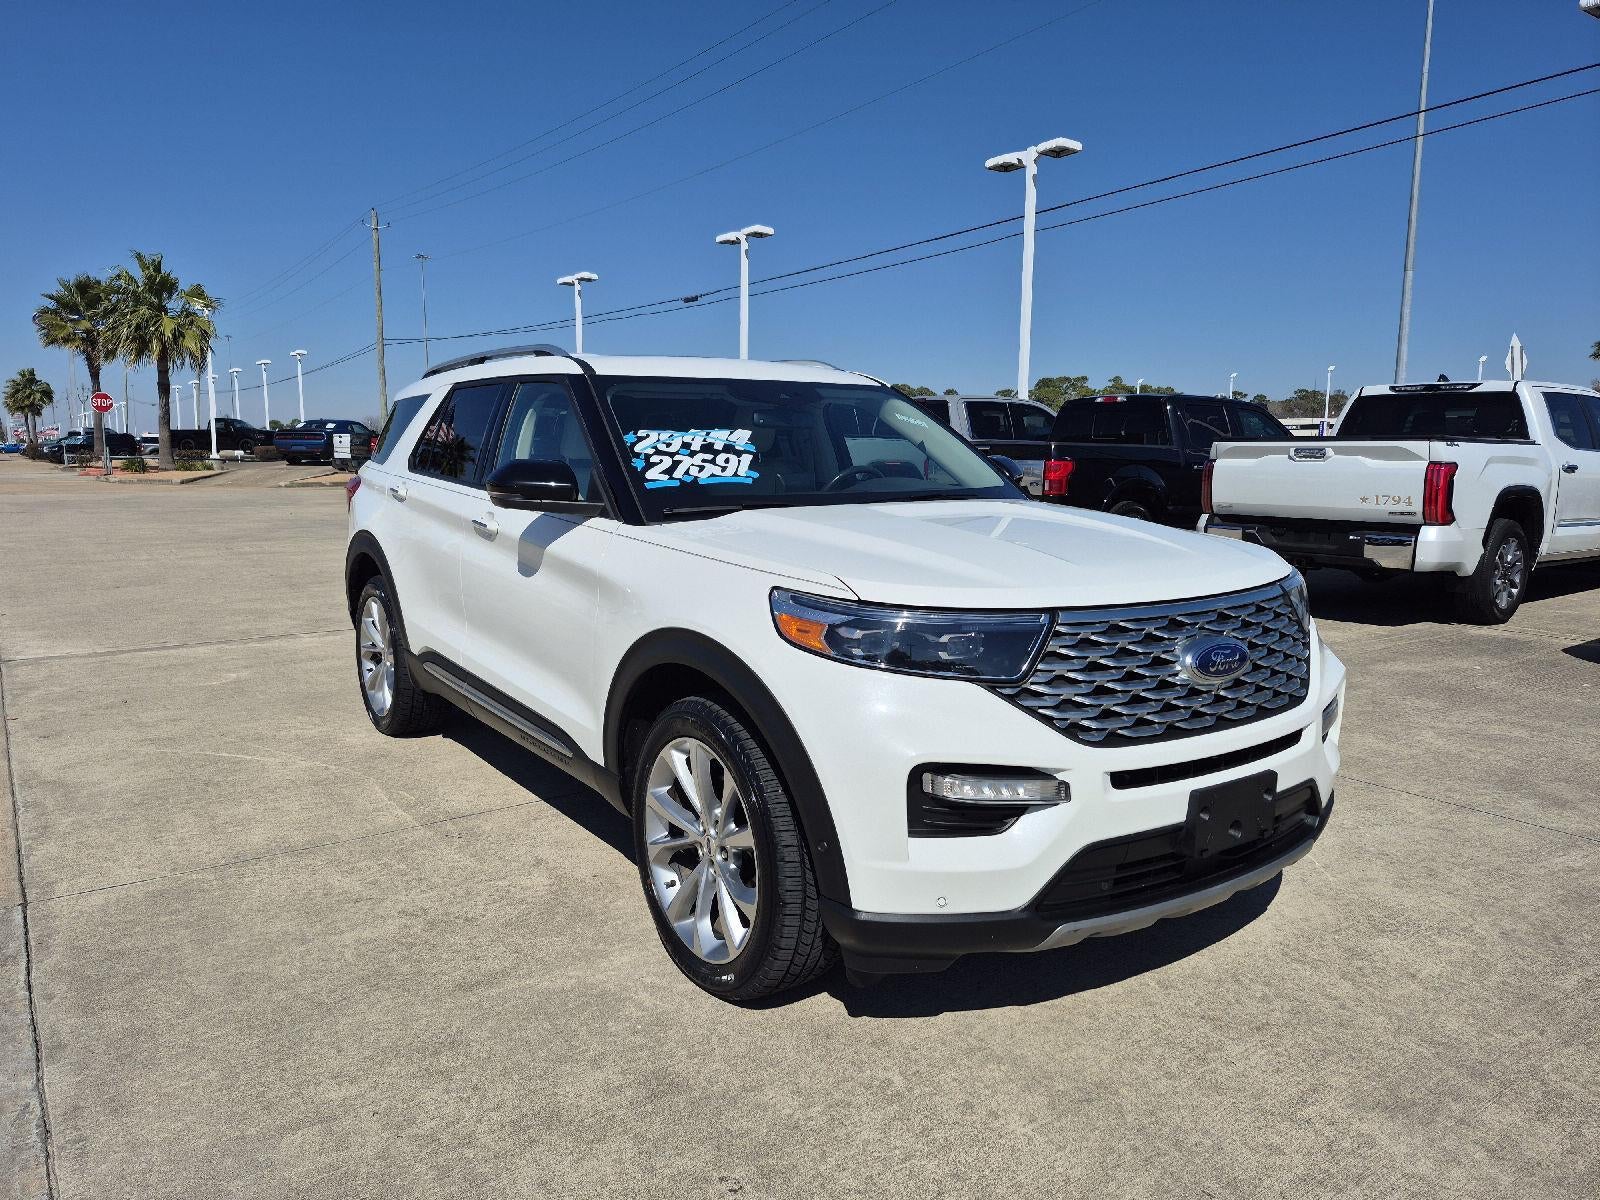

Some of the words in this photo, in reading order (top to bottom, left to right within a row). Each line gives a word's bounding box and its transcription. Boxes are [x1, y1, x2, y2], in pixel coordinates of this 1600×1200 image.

[92, 398, 112, 407] STOP
[1375, 495, 1413, 507] 1794
[1209, 649, 1240, 672] Ford
